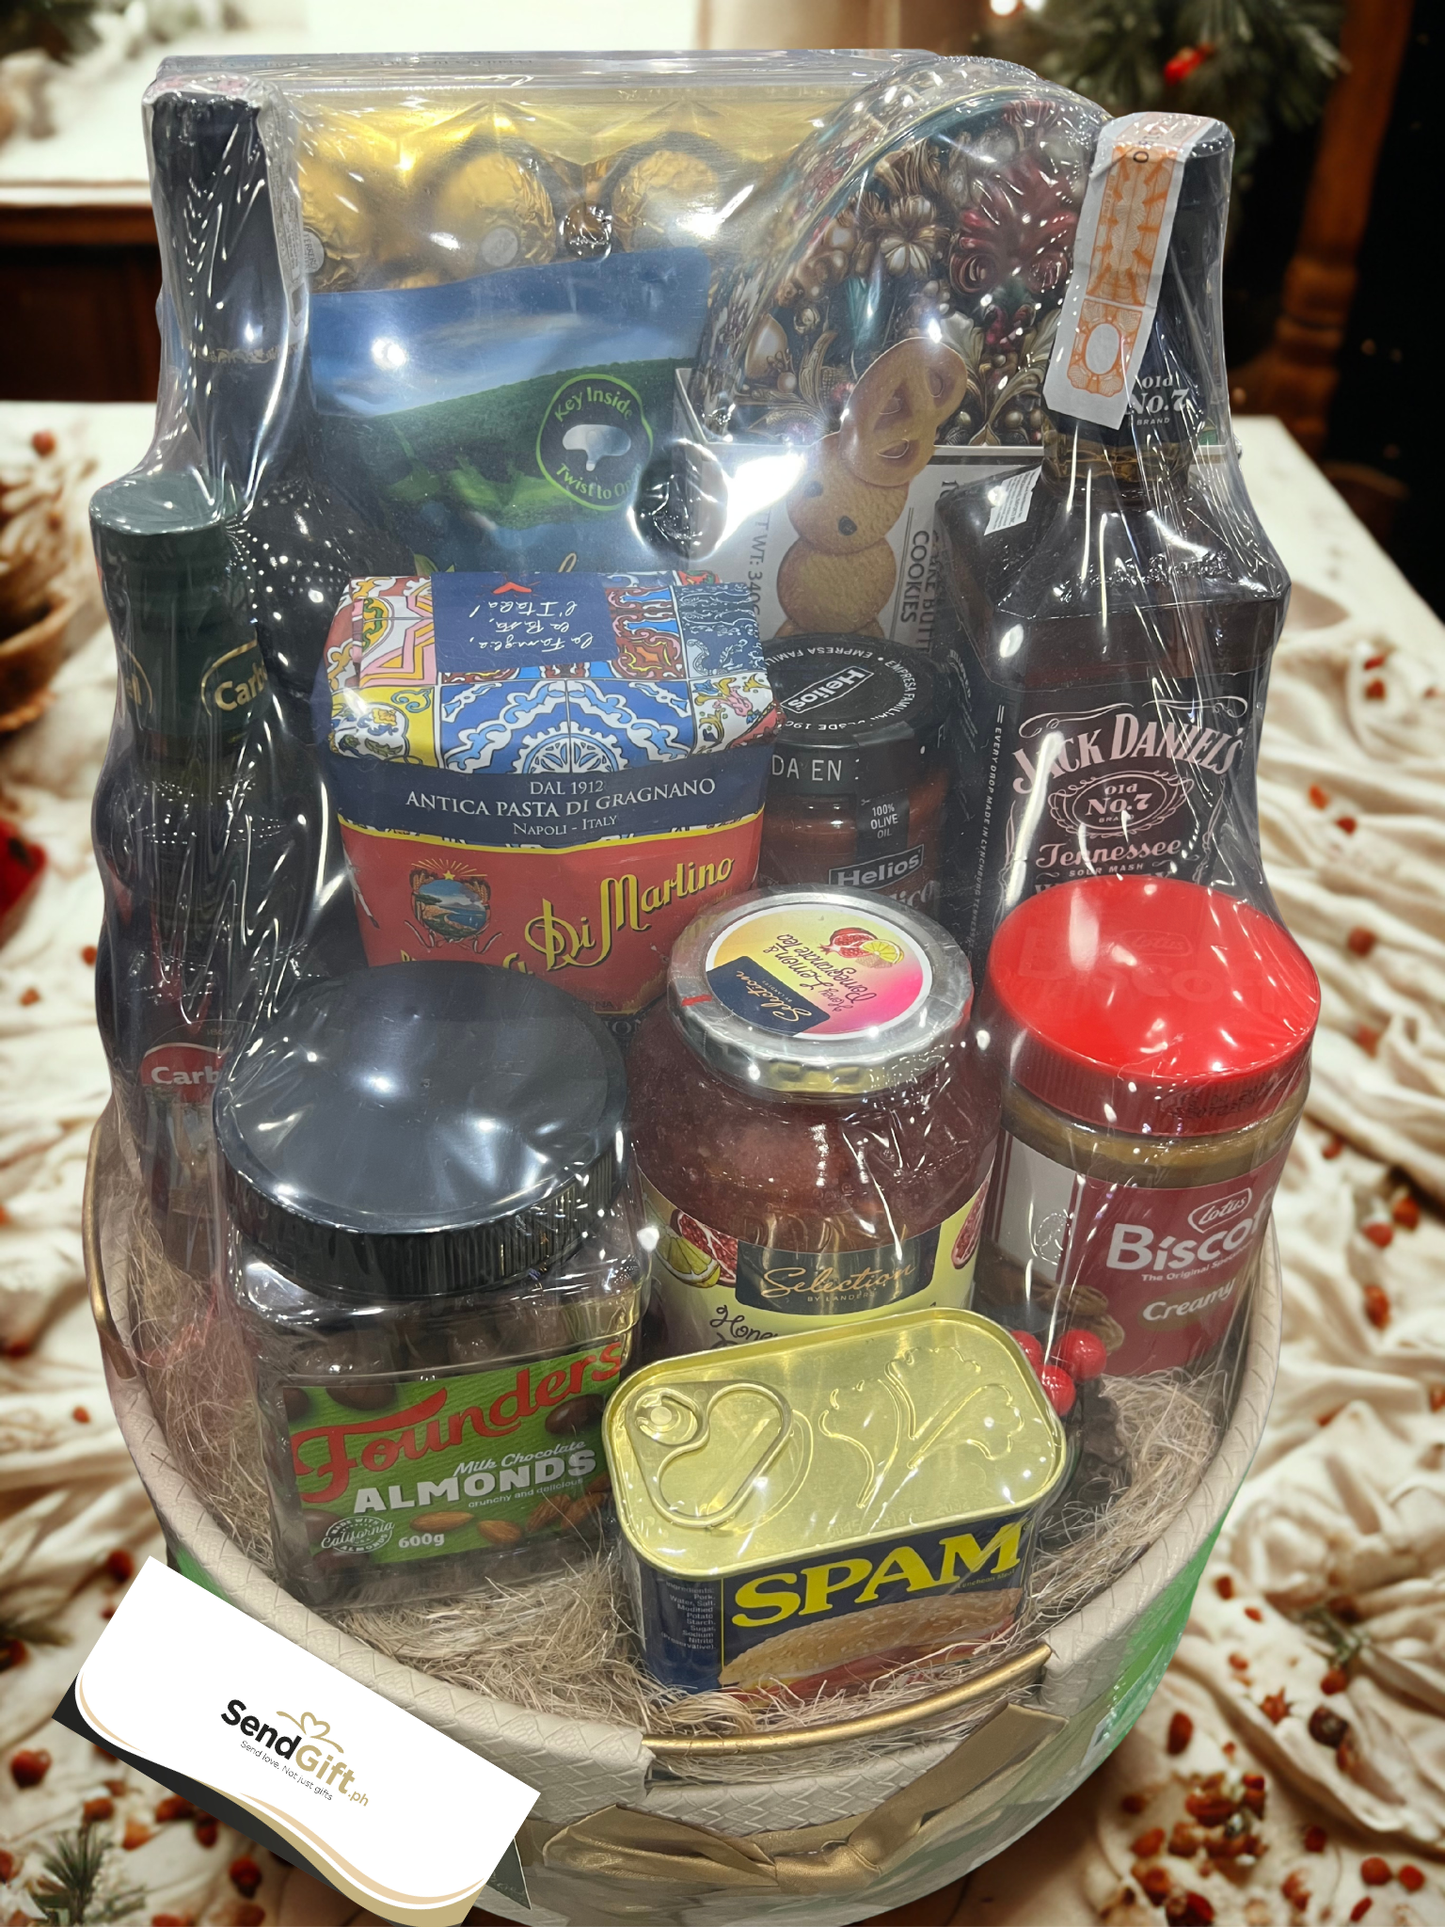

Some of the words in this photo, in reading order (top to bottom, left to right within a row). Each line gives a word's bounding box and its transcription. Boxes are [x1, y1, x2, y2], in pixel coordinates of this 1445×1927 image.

[555, 392, 582, 422] Key
[587, 387, 632, 420] Inside
[555, 462, 597, 498] Twist
[598, 483, 611, 499] to
[900, 529, 930, 624] COOKIES
[807, 646, 873, 660] EMPRESA
[788, 669, 866, 709] Helios
[885, 659, 916, 693] EMPRESA
[992, 727, 1002, 764] EVERY
[530, 781, 566, 795] DAL
[570, 780, 604, 796] 1912
[987, 765, 997, 793] DROP
[1104, 783, 1138, 795] Old
[405, 791, 491, 816] ANTICA
[497, 801, 559, 818] PASTA
[566, 801, 590, 816] DI
[596, 778, 717, 810] GRAGNANO
[872, 803, 895, 816] 100%
[982, 795, 993, 824] MADE
[870, 814, 899, 830] OLIVE
[877, 830, 892, 839] OIL
[837, 854, 920, 887] Helios
[1034, 839, 1183, 869] Tennessee
[1108, 863, 1145, 875] MASH
[572, 856, 736, 967] Martino
[776, 950, 830, 991] Lemon
[795, 948, 878, 1004] Pomegranate
[736, 970, 813, 1023] Selection
[820, 985, 854, 1013] Honey
[1198, 1196, 1247, 1226] Lotus
[761, 1264, 917, 1299] Selection
[1141, 1274, 1163, 1282] The
[1166, 1264, 1210, 1280] Original
[1143, 1278, 1237, 1321] Creamy
[709, 1304, 779, 1341] Hone
[291, 1342, 621, 1505] Founders
[453, 1462, 498, 1477] Milk
[501, 1441, 586, 1469] Chocolate
[354, 1449, 597, 1514] ALMONDS
[468, 1495, 512, 1509] crunchy
[514, 1488, 534, 1500] and
[536, 1478, 584, 1496] delicious
[320, 1522, 395, 1549] California
[398, 1533, 445, 1548] 600g
[732, 1521, 1023, 1627] SPAM
